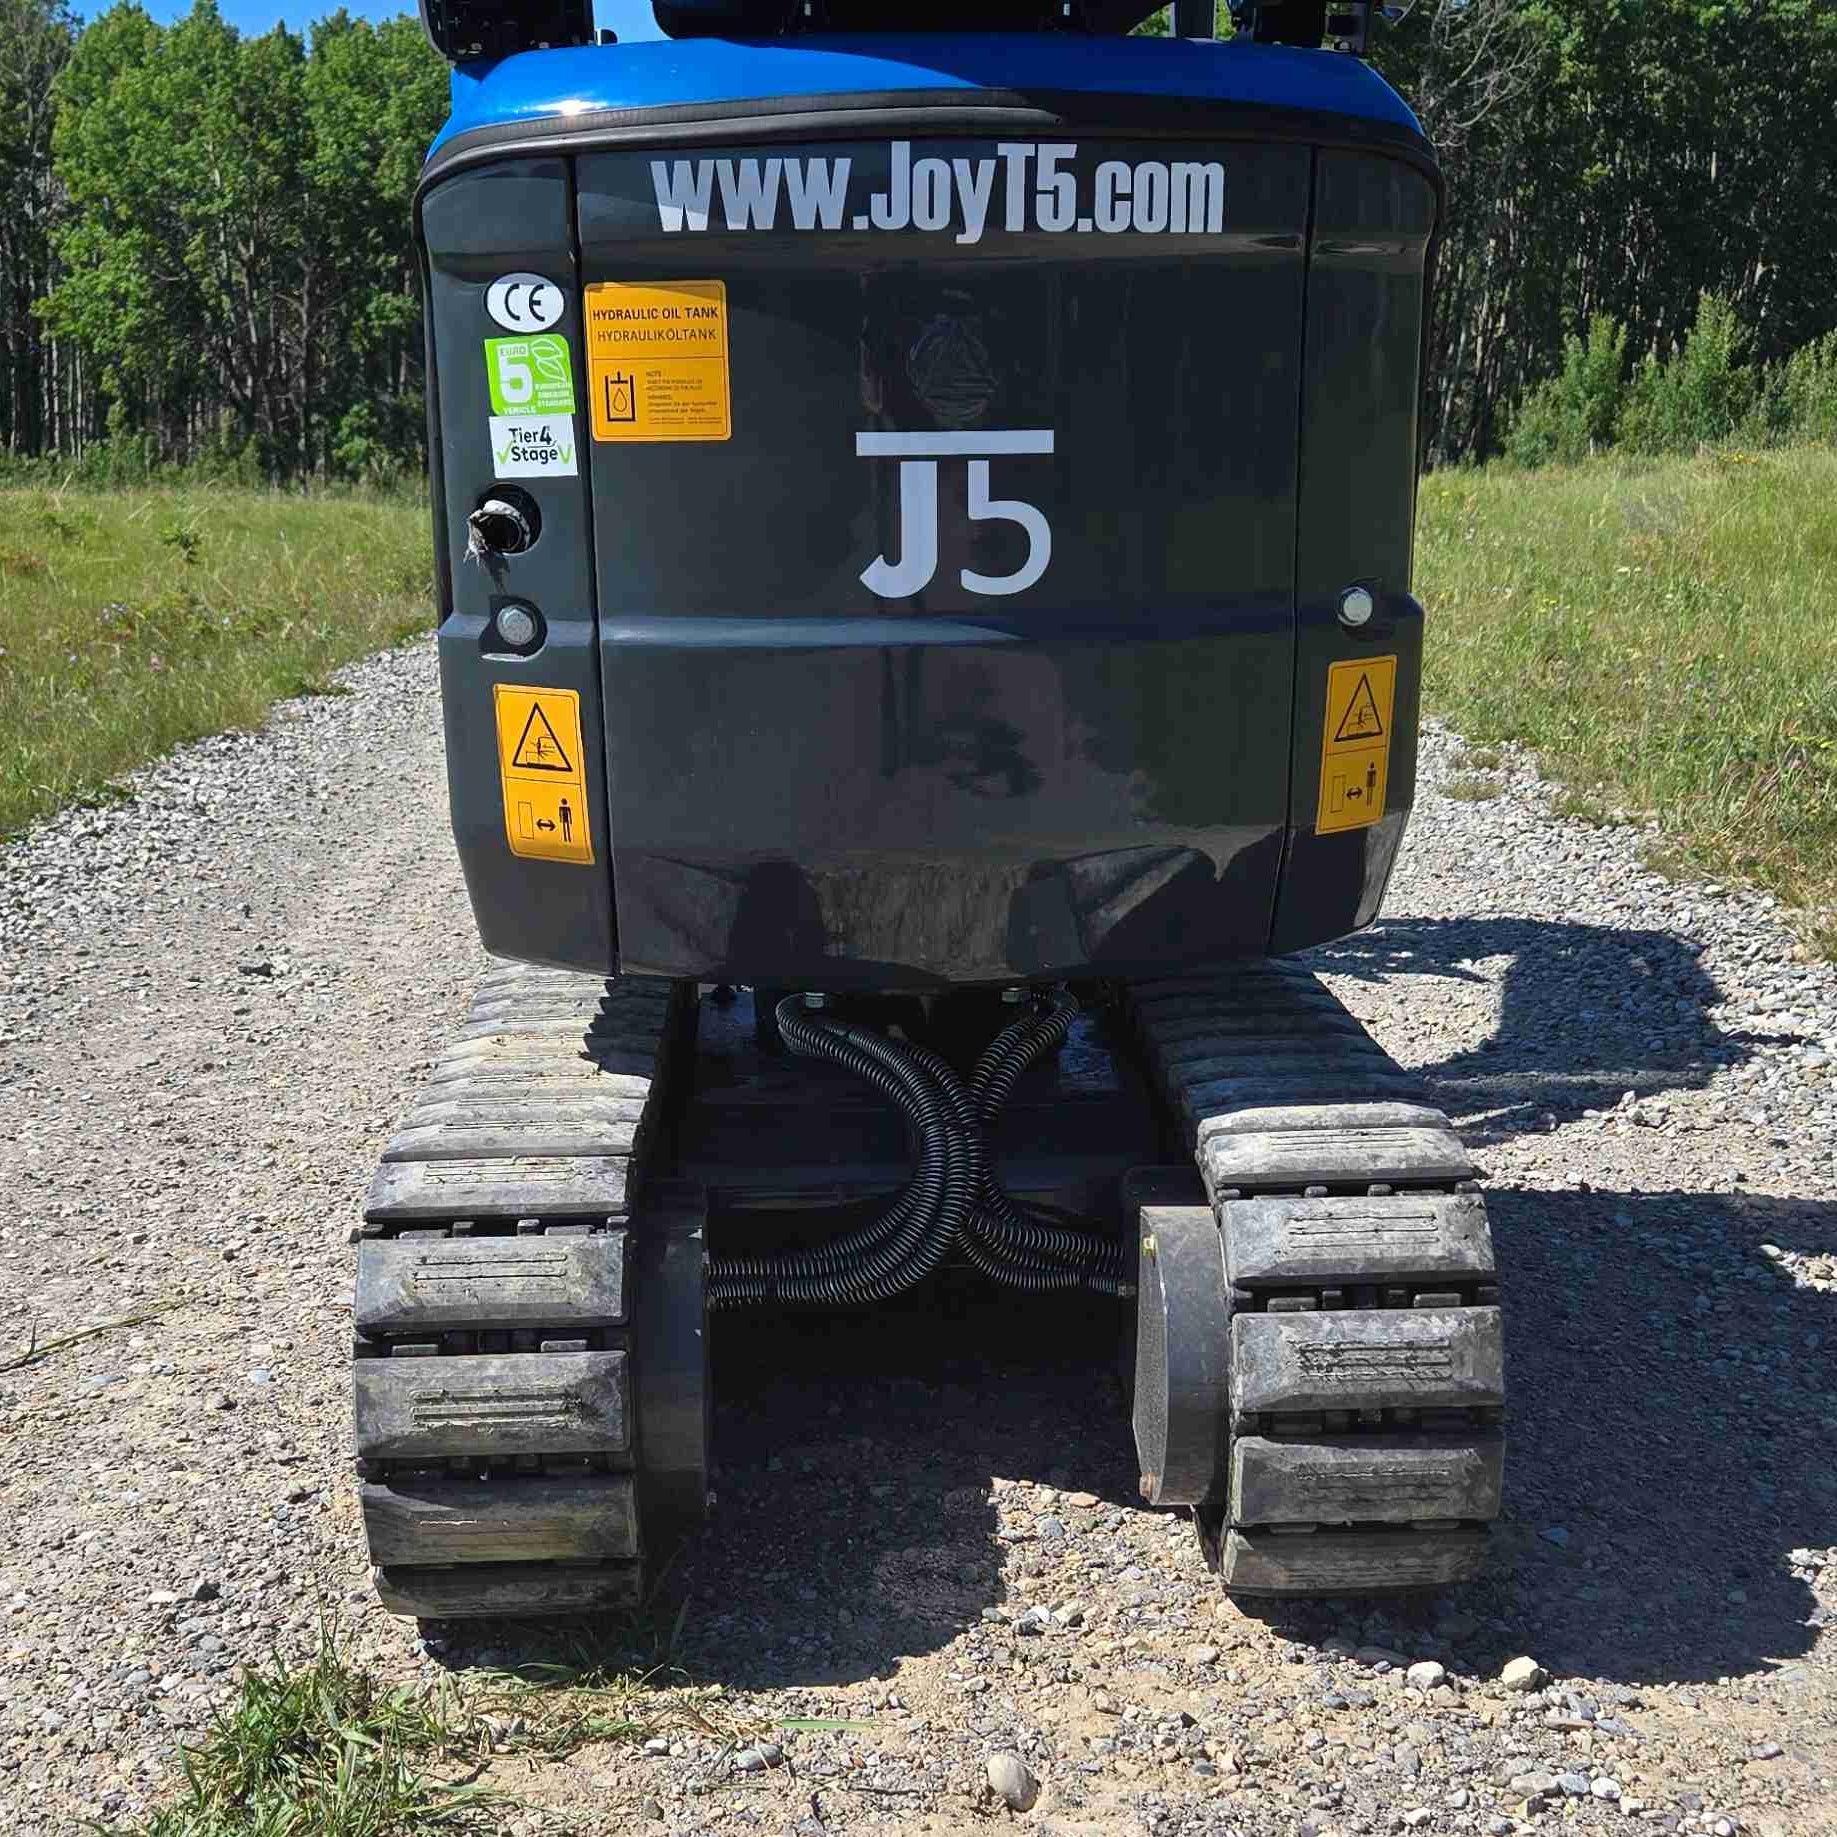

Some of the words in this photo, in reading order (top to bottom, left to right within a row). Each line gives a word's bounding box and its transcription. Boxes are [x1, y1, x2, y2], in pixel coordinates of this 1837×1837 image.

[650, 141, 1224, 245] www.JoyT5.com
[505, 283, 546, 322] CE
[592, 307, 658, 321] HYDRAULIC
[662, 307, 681, 320] OIL
[685, 306, 719, 319] TANK
[511, 446, 558, 465] Stage
